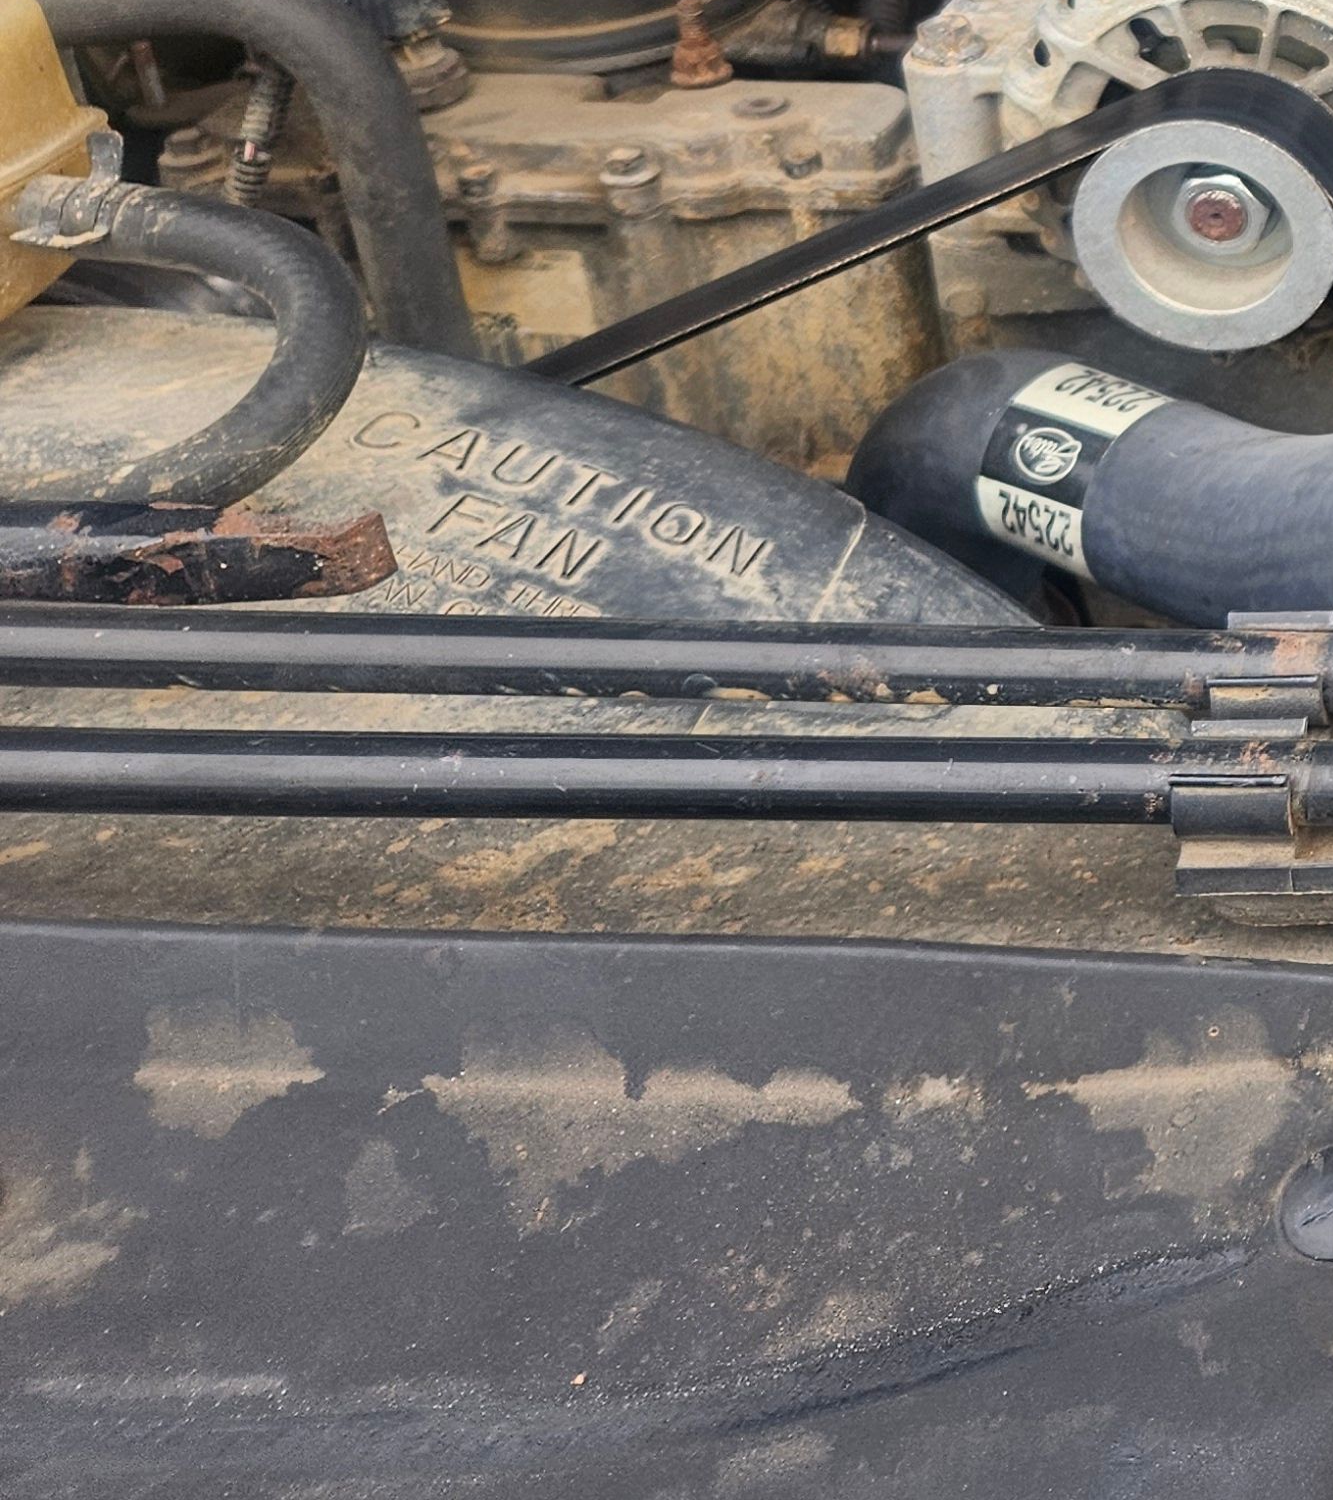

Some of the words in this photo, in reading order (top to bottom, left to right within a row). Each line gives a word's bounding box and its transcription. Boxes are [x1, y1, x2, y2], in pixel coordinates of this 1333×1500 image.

[1054, 369, 1162, 413] 22542
[351, 410, 771, 578] CAUTION
[998, 488, 1075, 558] 22542
[425, 493, 605, 581] FAN
